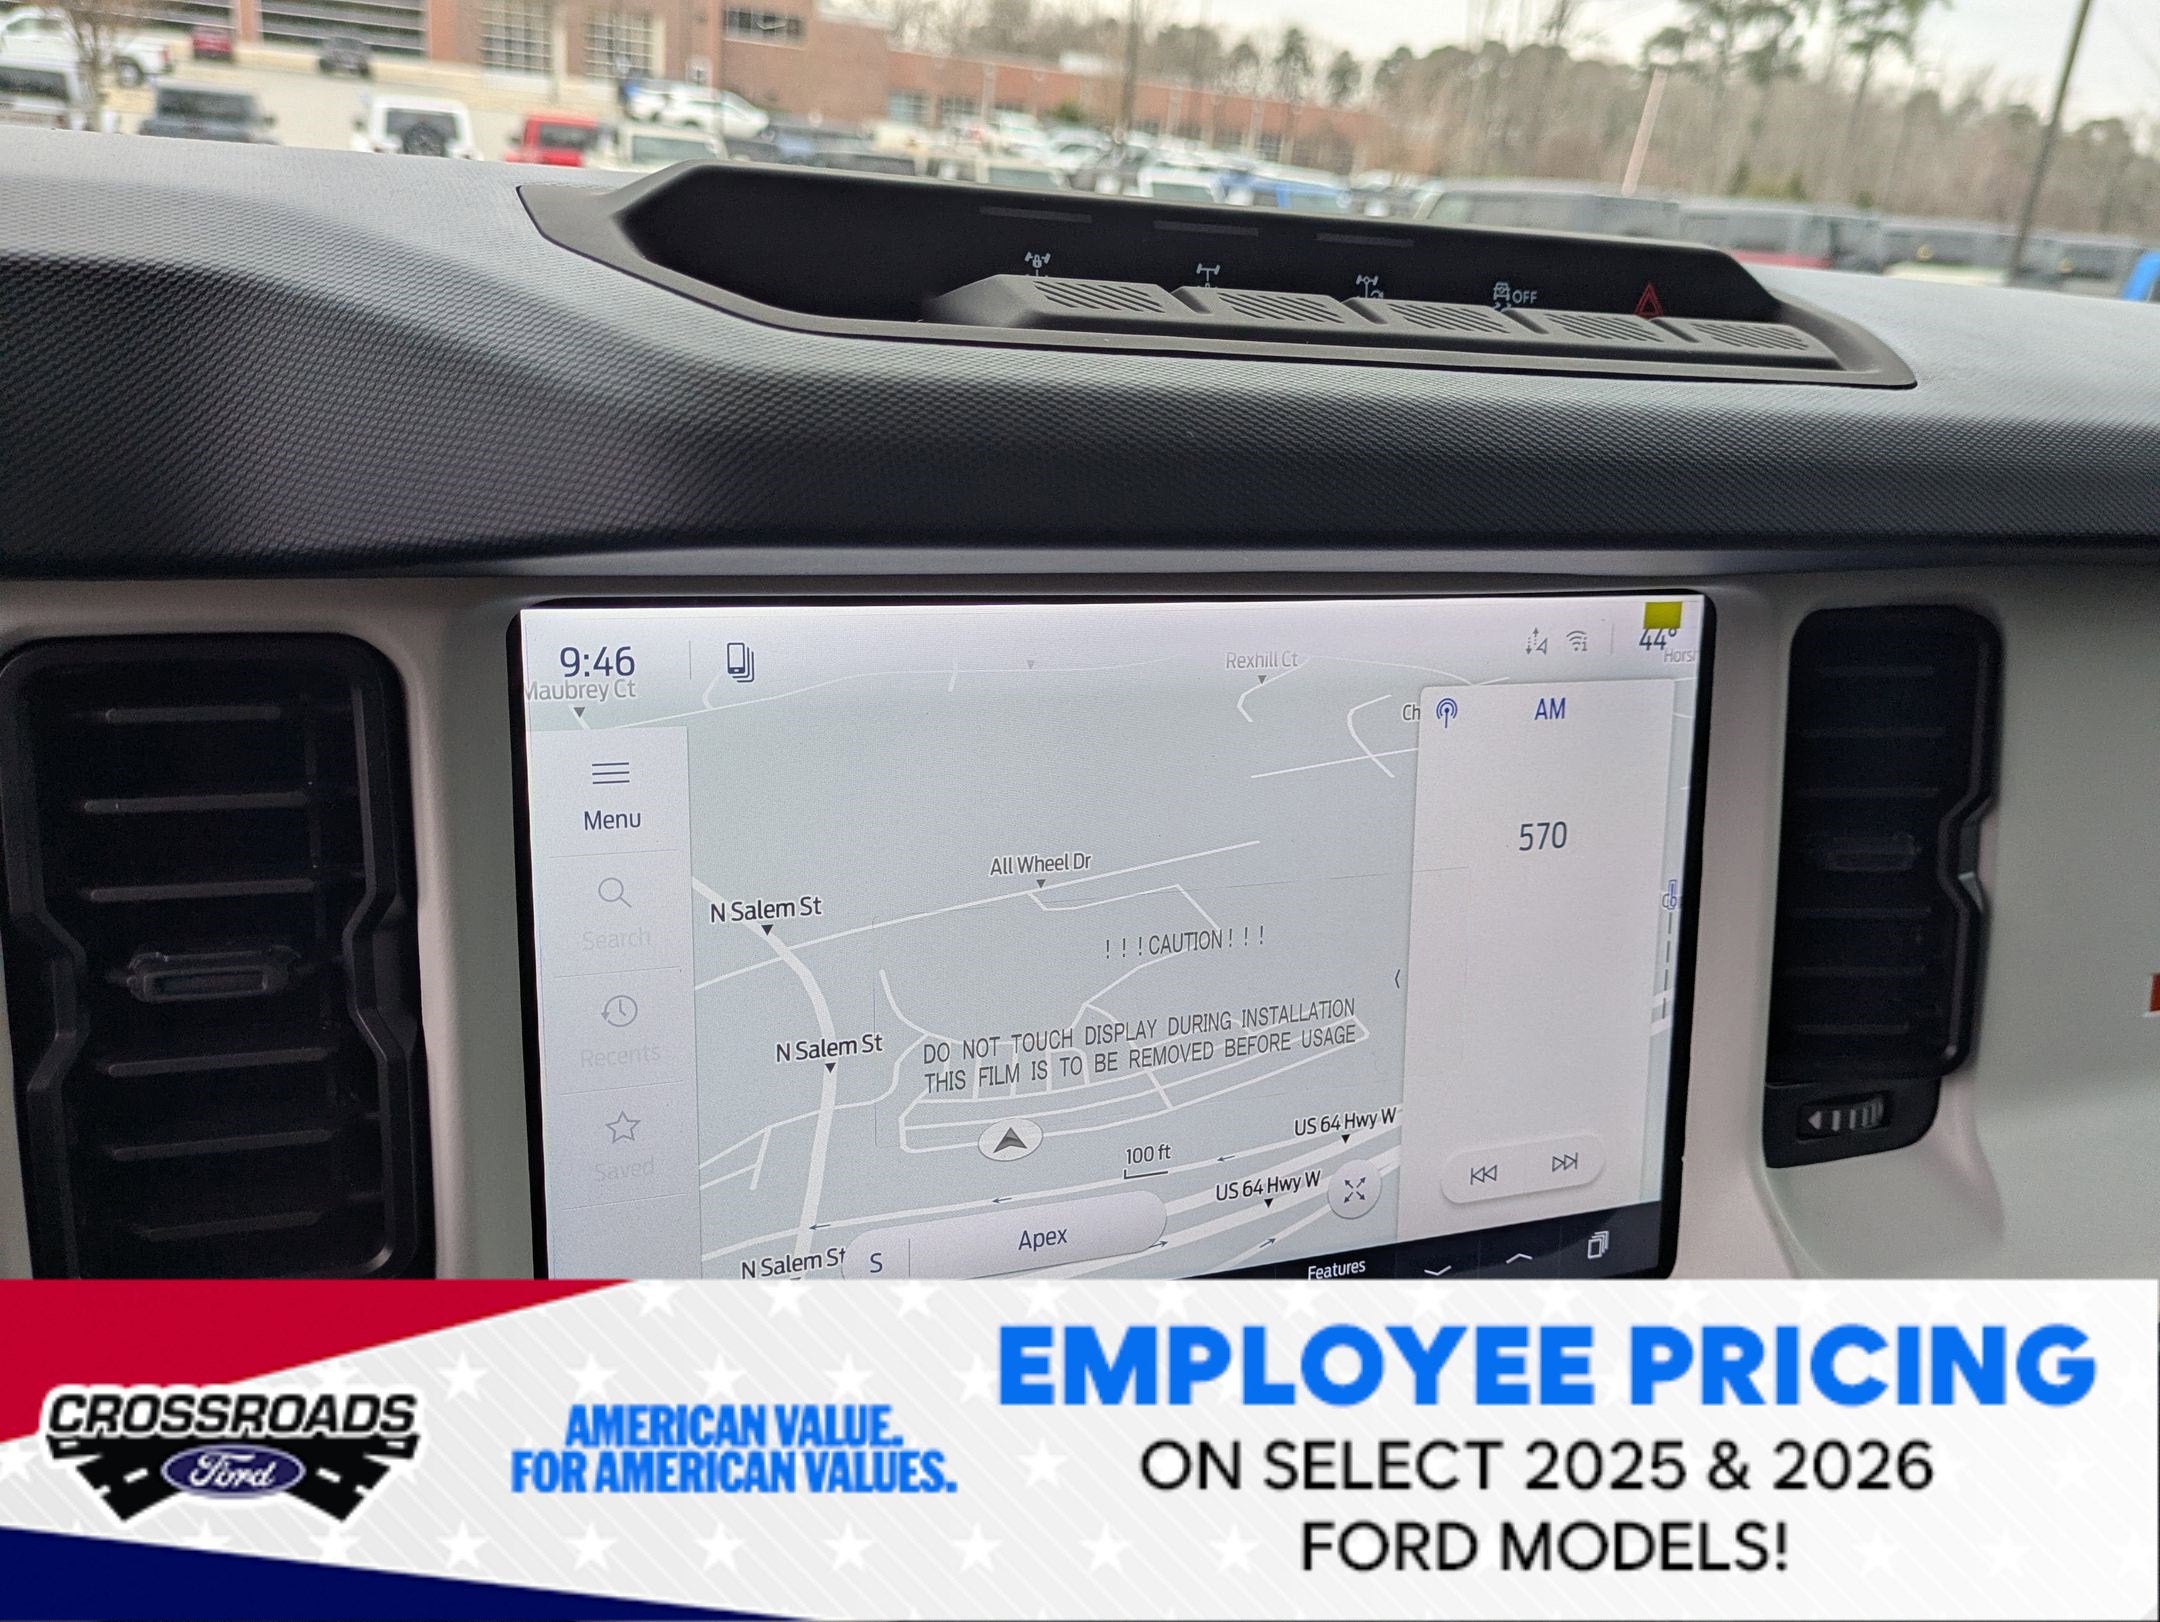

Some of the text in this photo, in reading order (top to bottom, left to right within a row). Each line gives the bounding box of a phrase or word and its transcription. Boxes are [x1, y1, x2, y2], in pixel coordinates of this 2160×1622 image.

[1511, 289, 1538, 304] OFF
[560, 646, 636, 678] 9:46
[1226, 651, 1299, 669] Rexhill Ct
[525, 679, 637, 702] Maubrey Ct
[1535, 698, 1567, 720] AM
[584, 809, 642, 831] Menu
[1519, 822, 1567, 852] 570
[990, 852, 1092, 876] All Wheel Dr
[710, 898, 823, 922] N Salem St
[581, 926, 652, 951] Search
[923, 998, 1355, 1064] DO NOT TOUCH DISPLAY DURING INSTALLATION
[580, 1042, 661, 1068] Recents
[776, 1034, 884, 1062] N Salem St
[925, 1024, 1356, 1094] THIS FILM IS TO BE REMOVED BEFORE USAGE
[1294, 1107, 1397, 1136] US 64 Hwy W
[1126, 1144, 1171, 1165] 100 ft
[1216, 1170, 1321, 1201] US 64 Hwy W
[1018, 1229, 1068, 1252] Apex
[741, 1261, 757, 1279] N
[761, 1254, 823, 1276] Salem
[870, 1252, 883, 1273] S
[1307, 1260, 1366, 1280] Features
